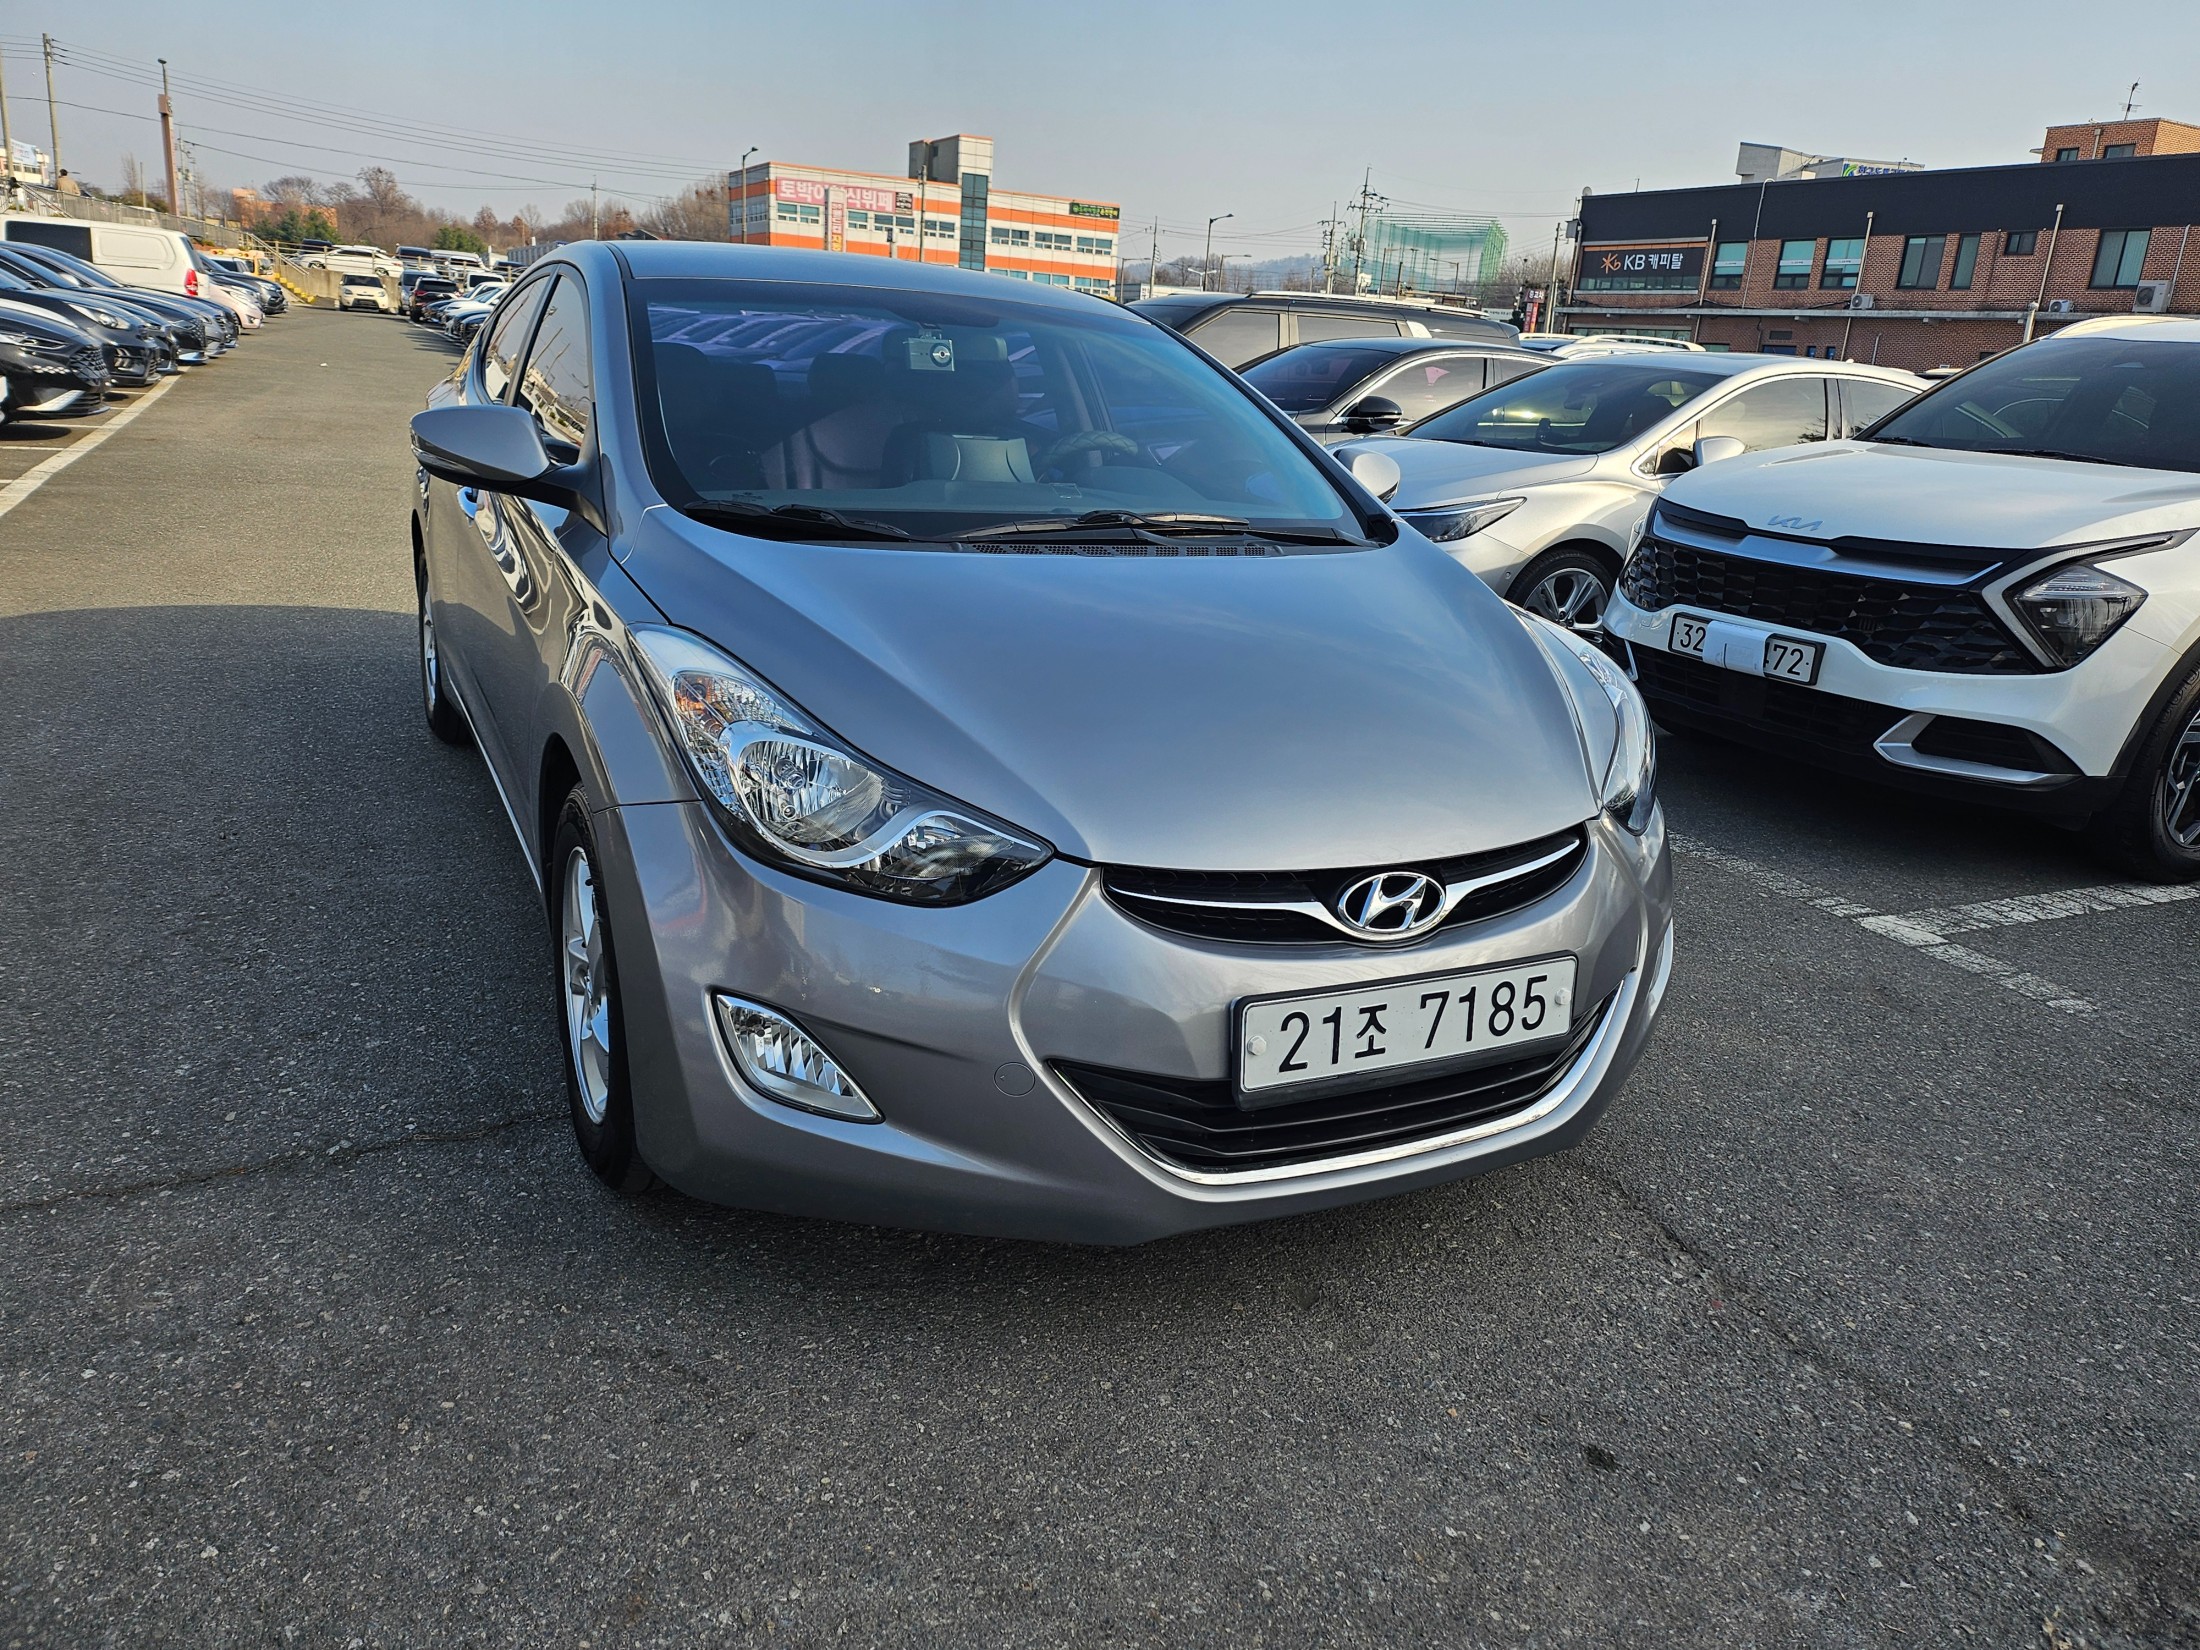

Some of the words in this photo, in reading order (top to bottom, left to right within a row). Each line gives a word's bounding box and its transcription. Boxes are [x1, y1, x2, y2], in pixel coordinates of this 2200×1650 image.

[1623, 254, 1646, 271] KB
[1648, 253, 1684, 270] 캐피탈
[1680, 623, 1706, 653] 32
[1278, 1003, 1388, 1073] 21조
[1419, 974, 1548, 1050] 7185
